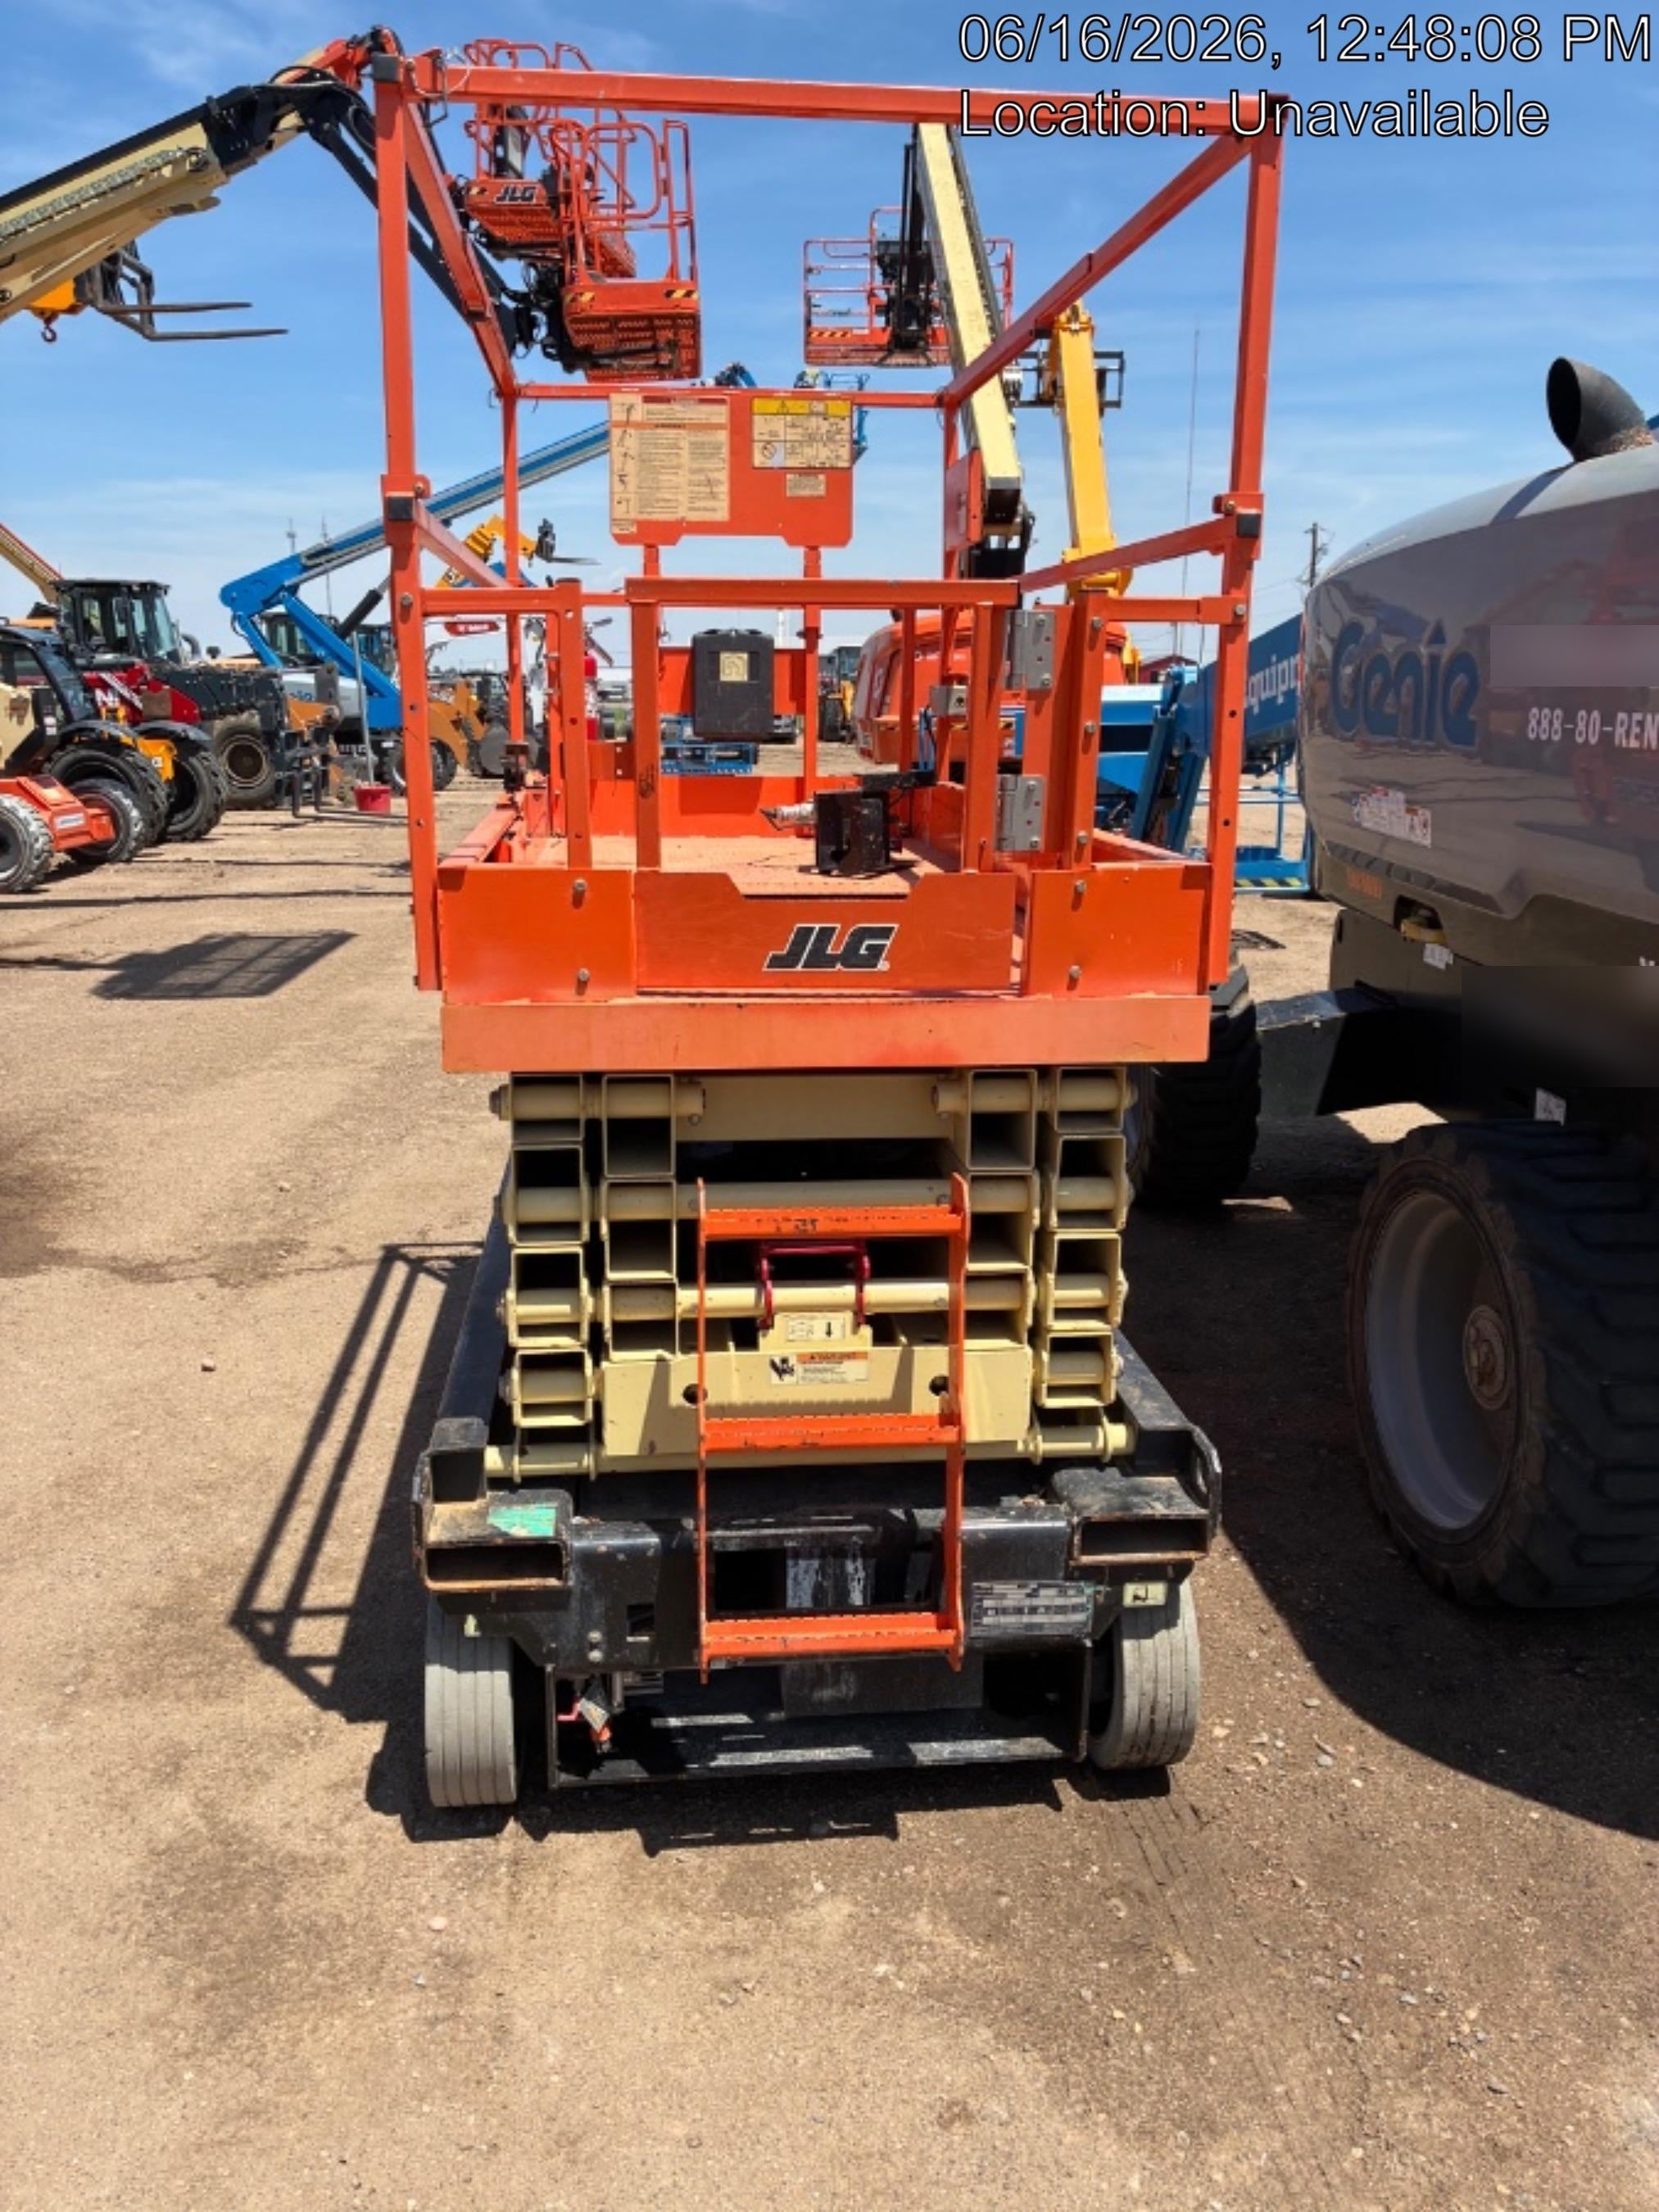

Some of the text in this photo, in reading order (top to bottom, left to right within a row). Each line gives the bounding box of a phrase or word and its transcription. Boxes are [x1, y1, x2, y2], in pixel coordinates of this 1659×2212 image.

[493, 184, 537, 204] JLG
[1331, 620, 1480, 748] Genie
[762, 923, 900, 972] JLG
